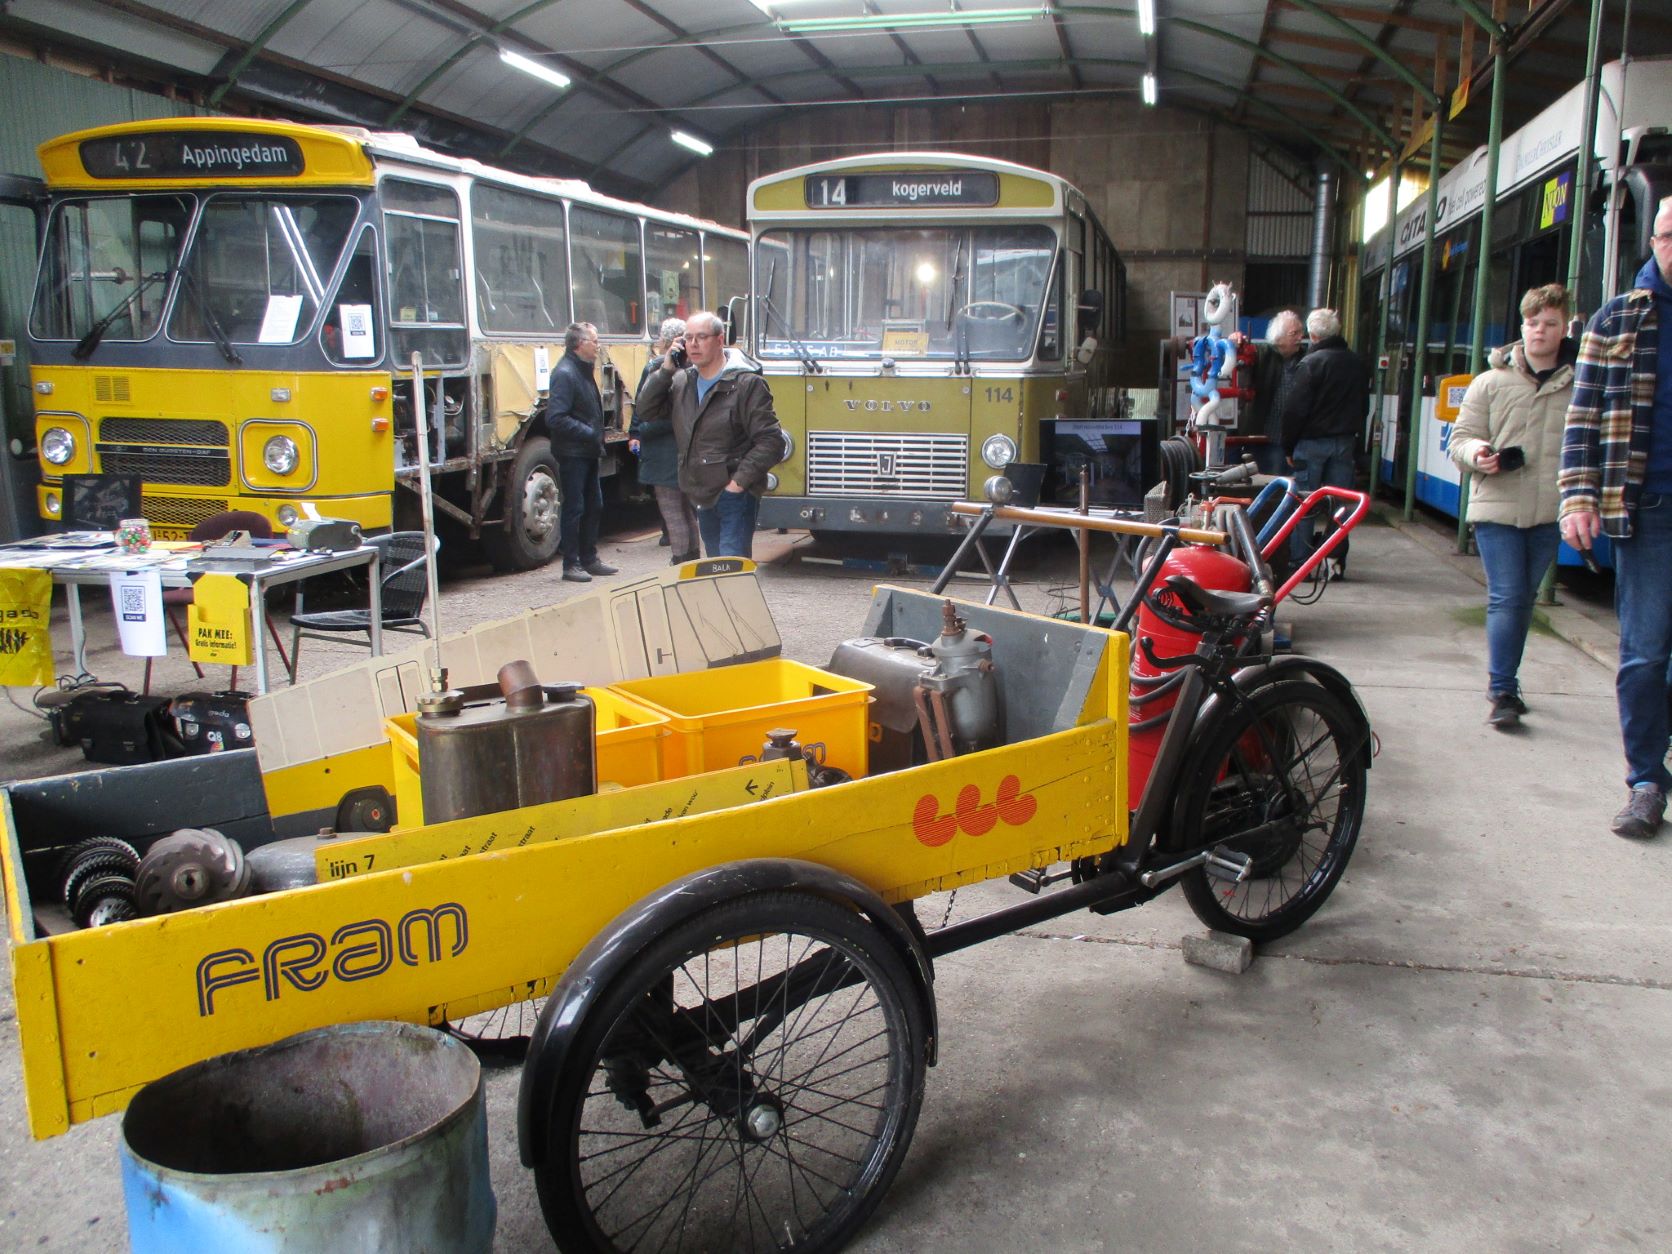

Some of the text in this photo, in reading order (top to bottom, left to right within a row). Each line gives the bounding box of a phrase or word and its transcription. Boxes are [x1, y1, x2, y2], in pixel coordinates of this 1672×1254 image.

[114, 142, 288, 170] 42 Appingedam
[820, 179, 962, 206] 14 kogerveld
[1400, 196, 1448, 246] CITAO
[985, 387, 1014, 403] 114
[844, 399, 932, 412] VOLVO
[198, 628, 212, 639] PAK
[207, 731, 222, 742] Q8
[330, 854, 375, 879] lijn 7
